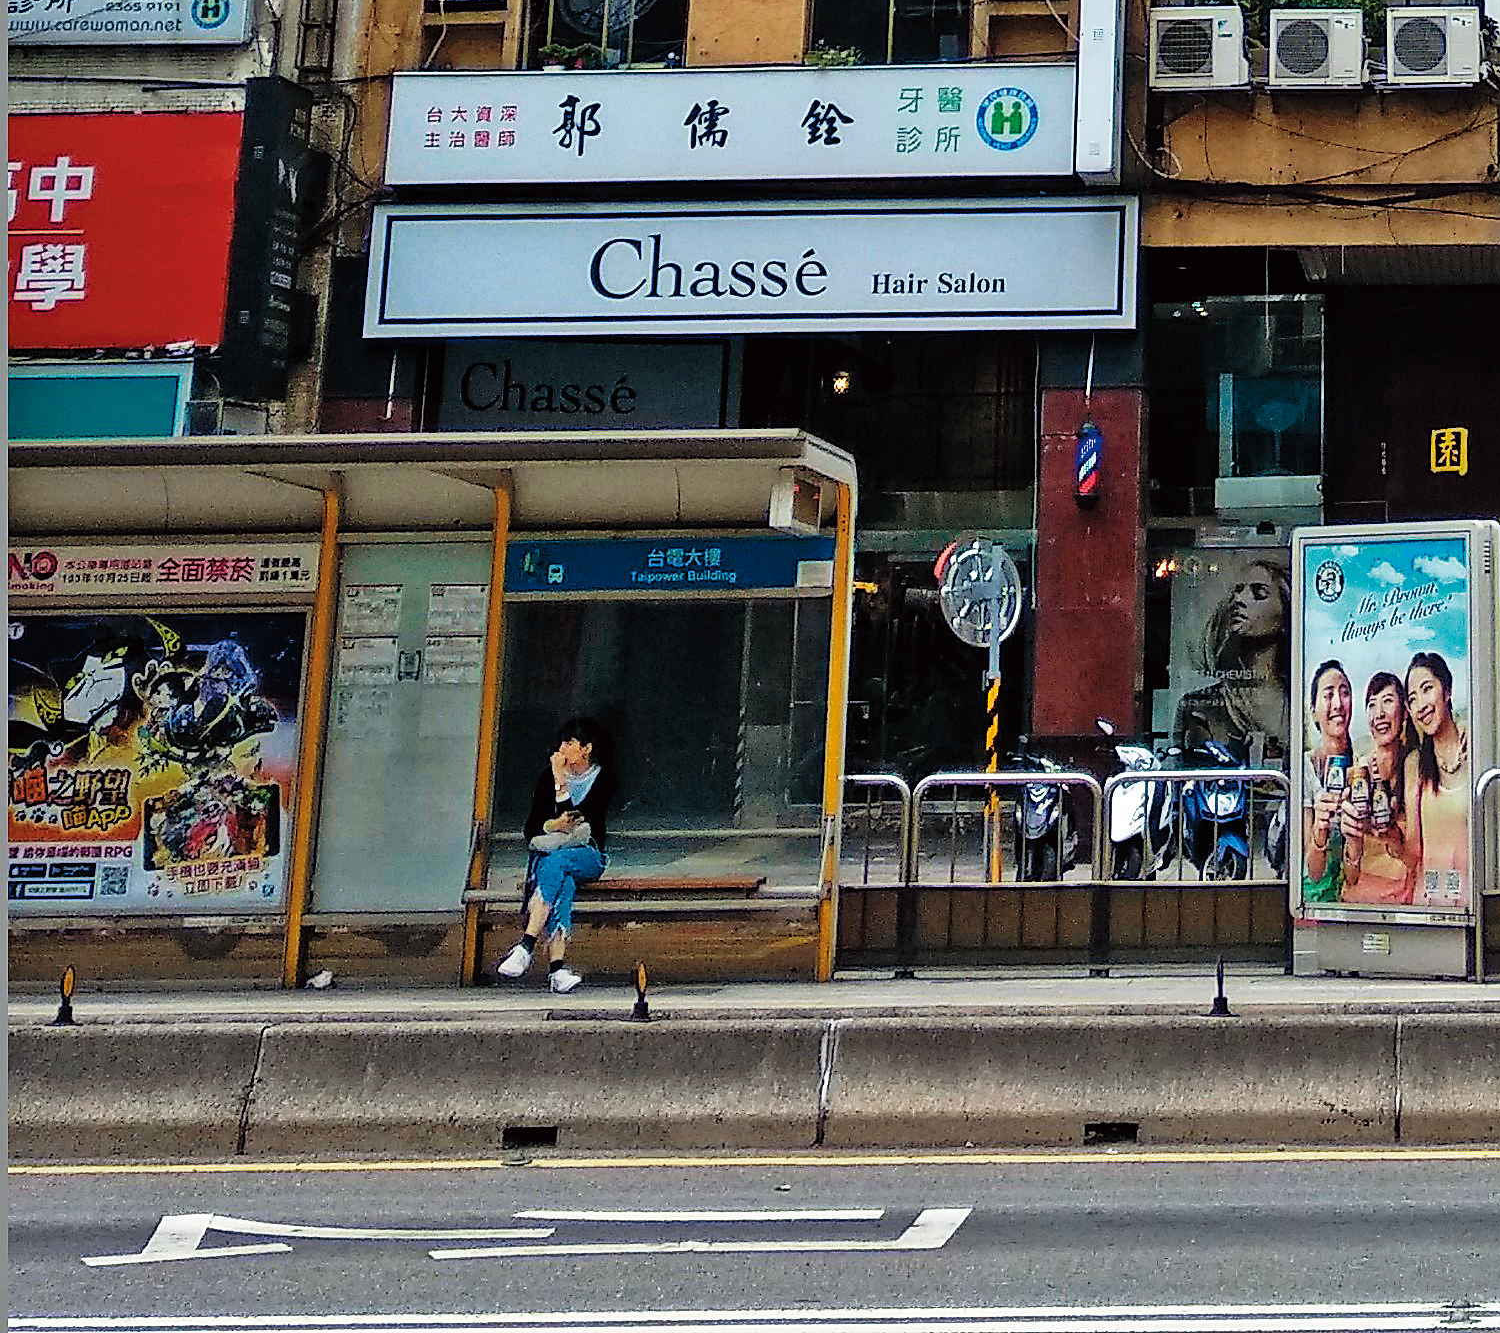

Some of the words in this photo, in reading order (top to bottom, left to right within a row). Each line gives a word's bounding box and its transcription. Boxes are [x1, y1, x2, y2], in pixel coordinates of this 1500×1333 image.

[426, 105, 518, 124] 台大資深
[423, 130, 516, 149] 主治醫師
[8, 156, 96, 223] 中
[589, 234, 829, 300] Chassé
[871, 272, 929, 296] Hair
[936, 270, 1007, 295] Salon
[459, 359, 638, 416] Chassé
[156, 556, 256, 583] 全面禁菸
[647, 547, 722, 568] 台電大樓
[630, 570, 687, 583] Taipower
[688, 569, 738, 583] Building
